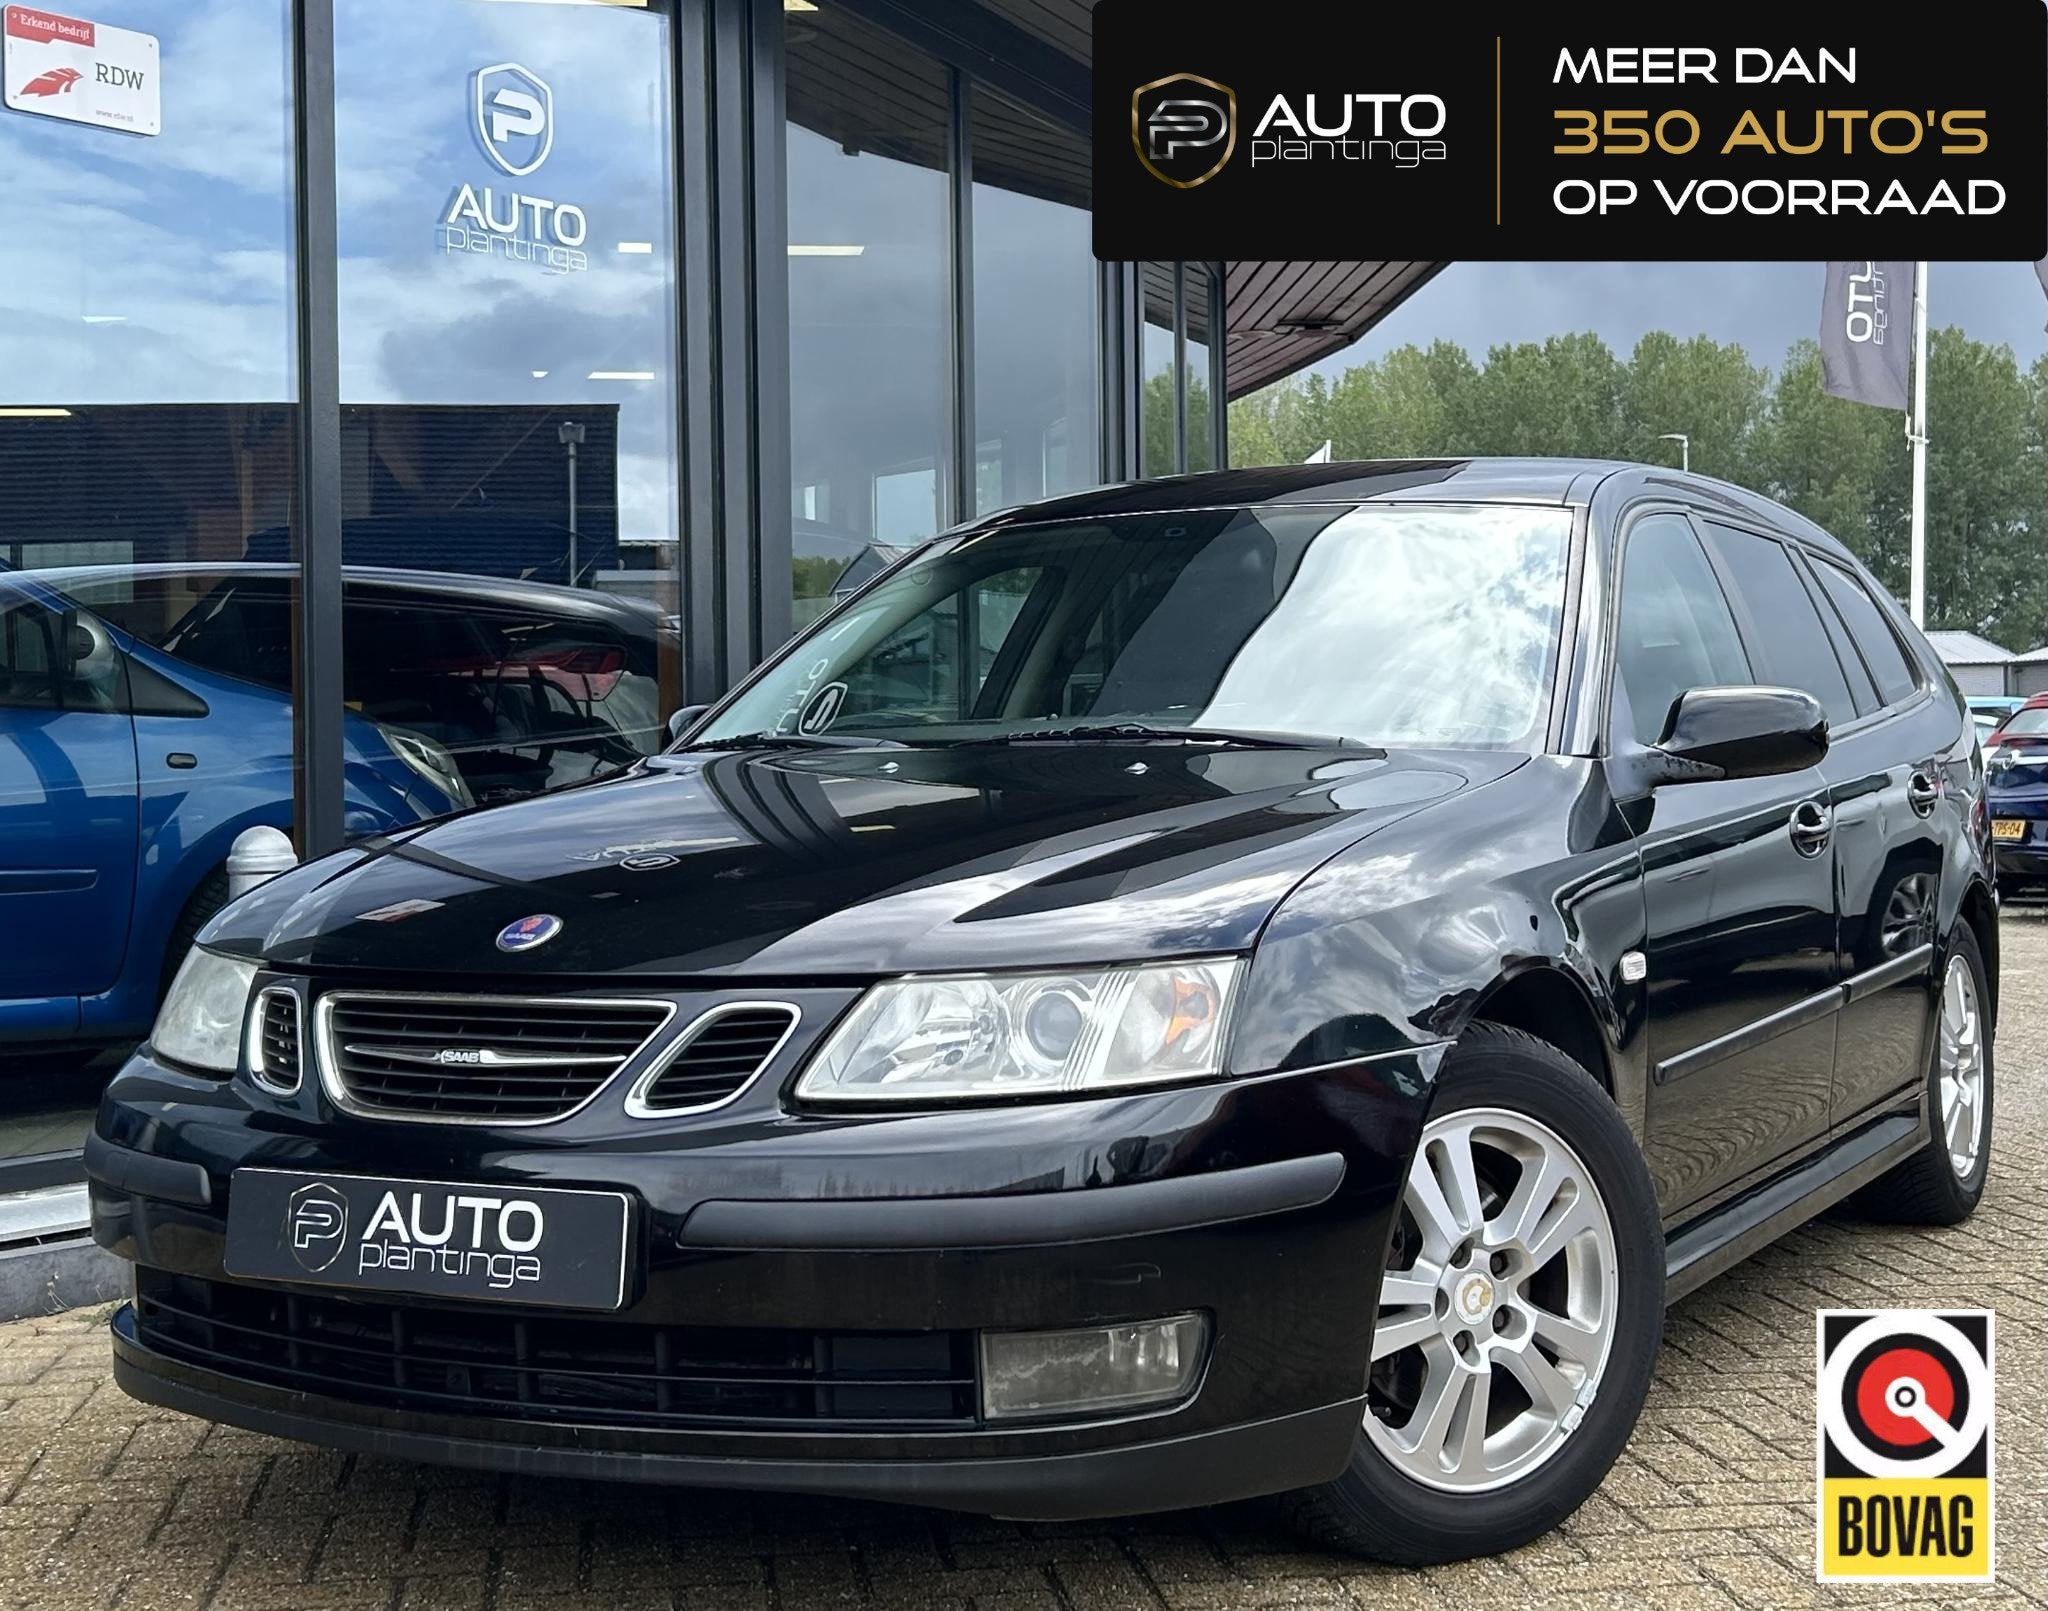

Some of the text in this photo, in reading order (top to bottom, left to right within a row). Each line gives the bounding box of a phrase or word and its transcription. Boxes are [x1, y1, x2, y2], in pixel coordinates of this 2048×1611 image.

[20, 13, 91, 41] Erkend bedrijf
[95, 62, 144, 91] RDW
[447, 183, 587, 247] AUTO
[446, 225, 588, 275] plantinga
[442, 1050, 480, 1064] SAAB
[360, 1190, 545, 1253] AUTO
[358, 1242, 542, 1289] plantinga
